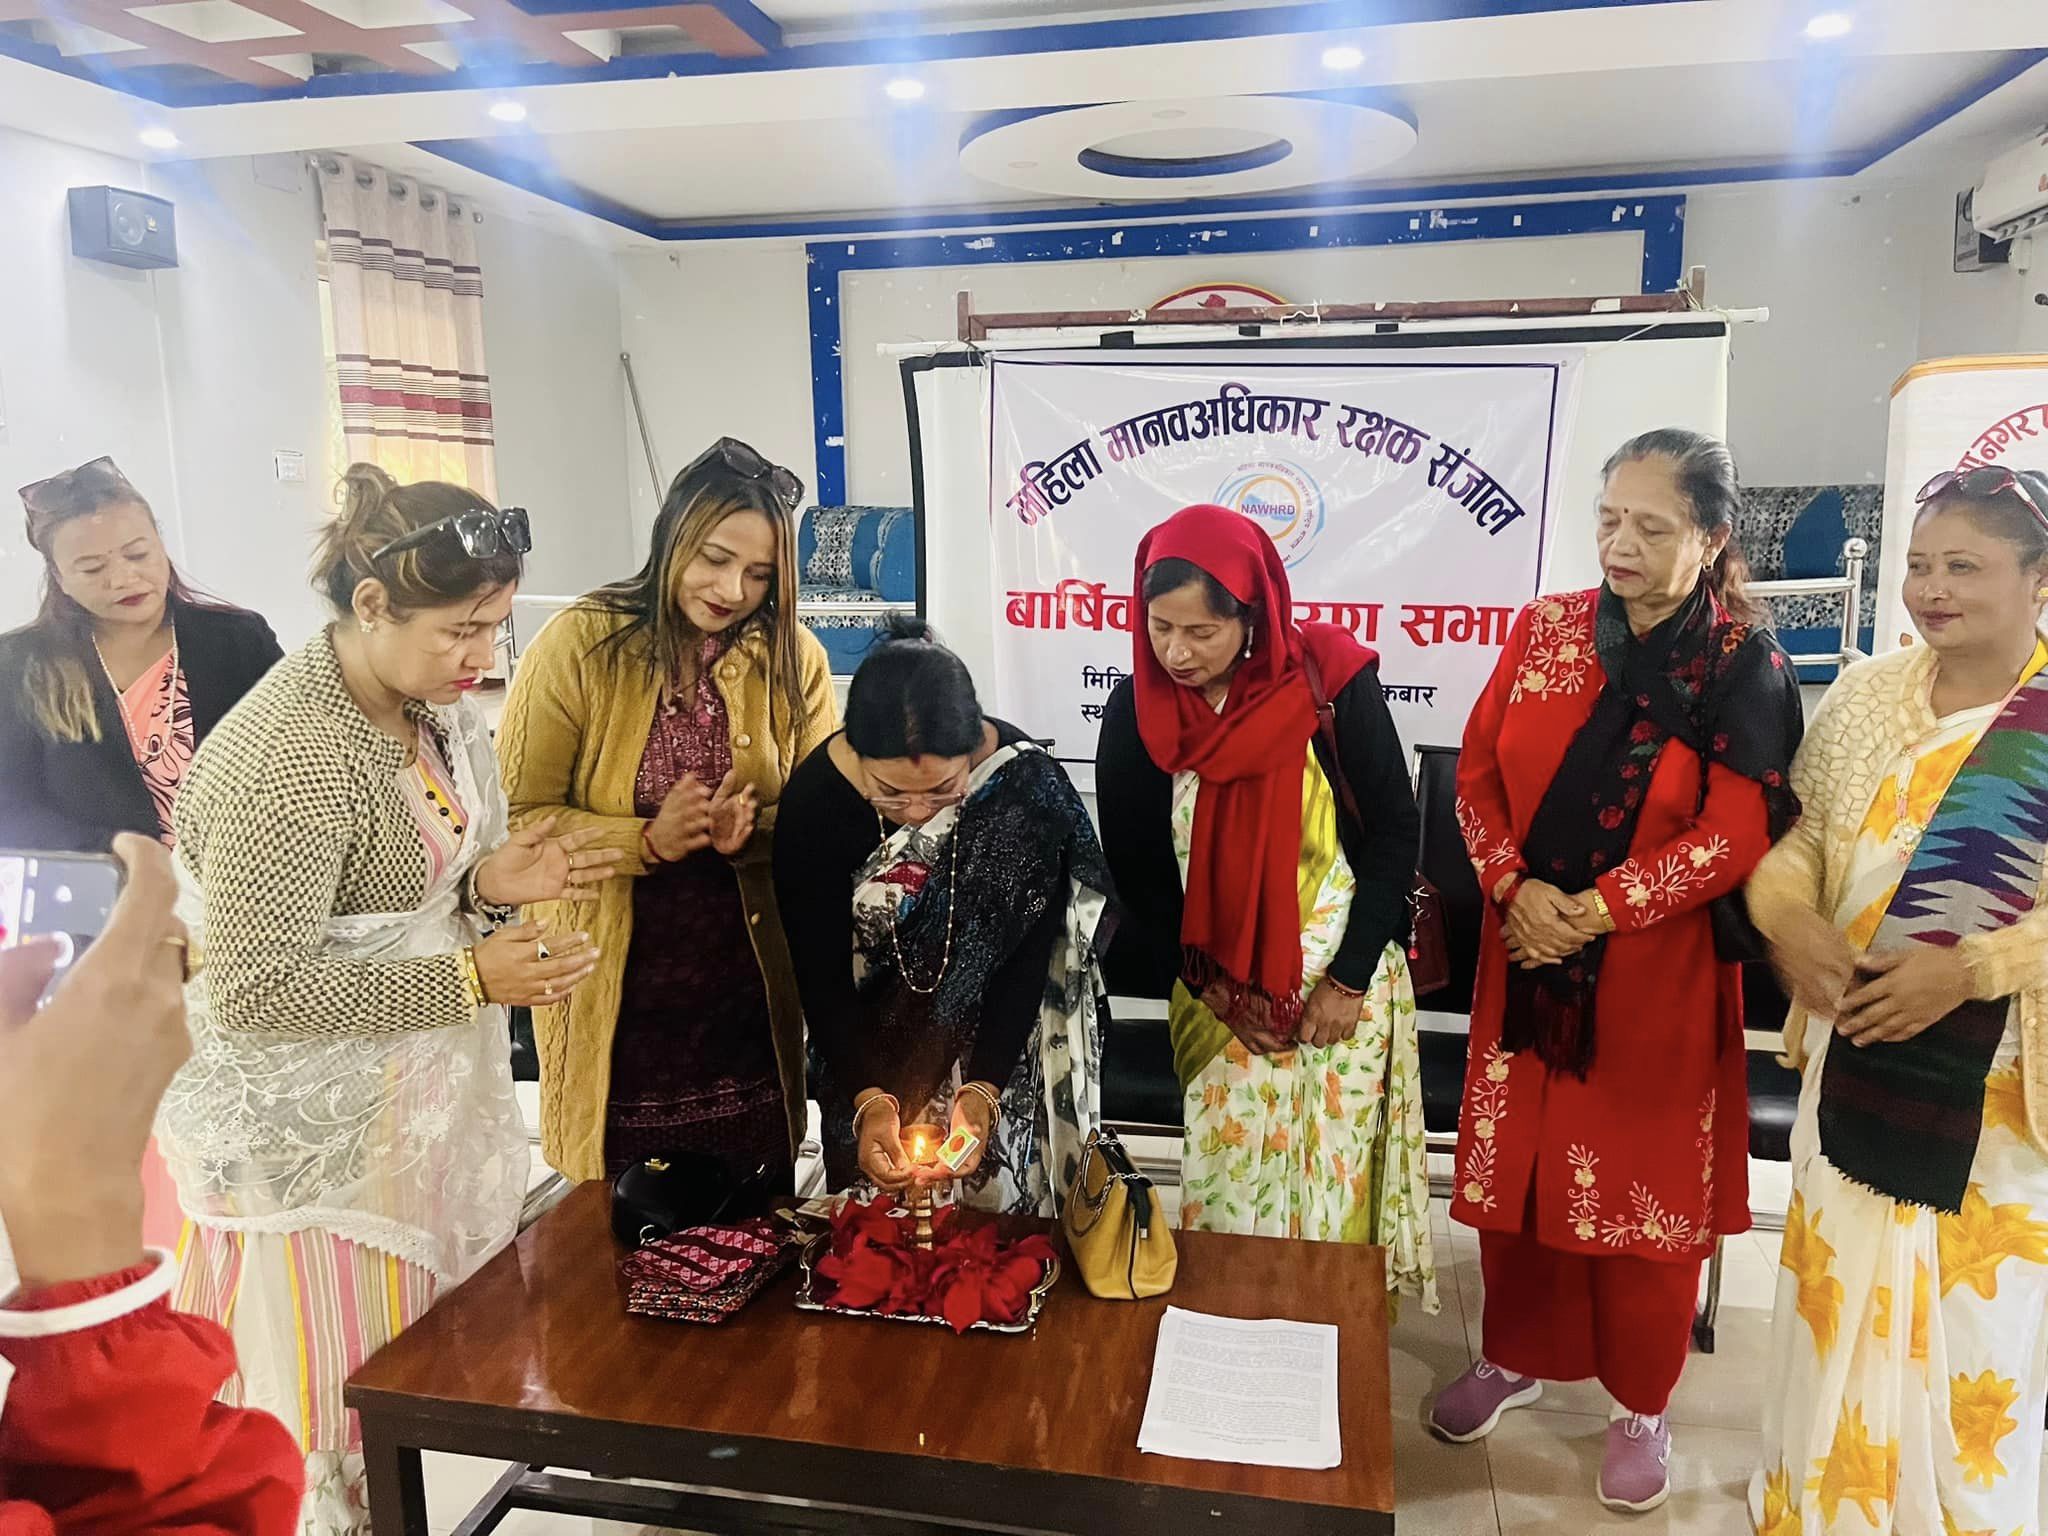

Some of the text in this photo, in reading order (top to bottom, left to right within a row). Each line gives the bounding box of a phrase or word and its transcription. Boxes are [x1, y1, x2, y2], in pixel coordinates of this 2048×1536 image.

[1005, 438, 1103, 526] महिला
[1337, 404, 1431, 465] रक्षक
[1427, 443, 1526, 536] संजाल
[1241, 503, 1296, 515] NAWHRD
[1401, 604, 1514, 646] सभा
